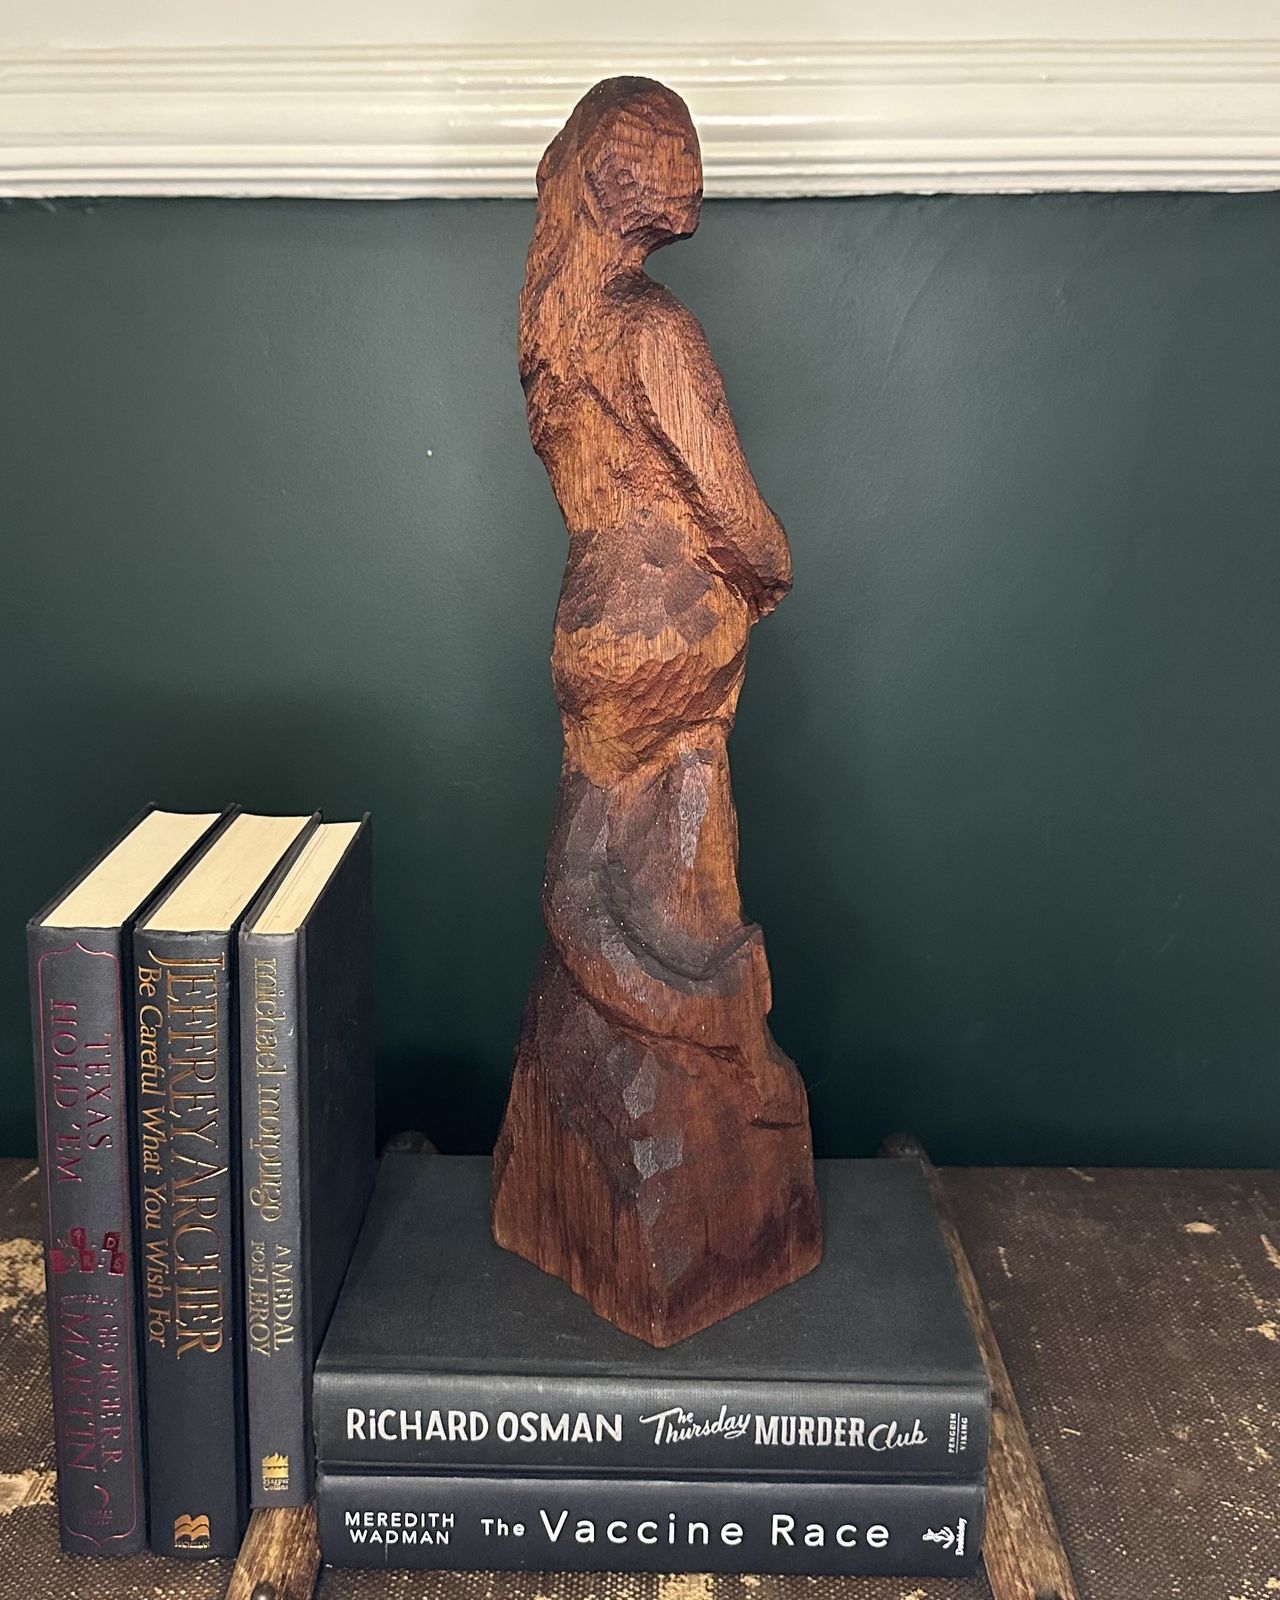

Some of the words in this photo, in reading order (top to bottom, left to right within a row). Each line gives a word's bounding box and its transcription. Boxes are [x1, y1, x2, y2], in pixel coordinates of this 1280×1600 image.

[138, 965, 162, 997] Be
[140, 1004, 167, 1095] Careful
[147, 950, 226, 1148] JEFFREY
[254, 958, 287, 1077] michael
[50, 999, 79, 1109] HOLD
[84, 1033, 113, 1149] TEXAS
[141, 1106, 167, 1175] What
[249, 1083, 282, 1221] morpurgo
[144, 1183, 167, 1230] You
[145, 1239, 169, 1298] Wish
[170, 1150, 228, 1360] ARCHER
[251, 1240, 265, 1274] FOR
[275, 1244, 291, 1258] A
[147, 1307, 171, 1348] For
[248, 1274, 271, 1357] LEROY
[271, 1261, 295, 1350] MEDAL
[61, 1312, 97, 1472] MARTIN
[98, 1313, 121, 1419] GEORGE
[497, 1411, 623, 1443] OSMAN
[639, 1404, 751, 1446] Thursday
[754, 1414, 865, 1447] MURDER
[867, 1418, 928, 1451] Club
[947, 1412, 957, 1453] PENGUIN
[959, 1416, 968, 1450] VIKING
[345, 1511, 455, 1528] MEREDITH
[349, 1528, 450, 1545] WADMAN
[480, 1518, 525, 1537] The
[539, 1509, 744, 1546] Vaccine
[771, 1513, 890, 1548] Race
